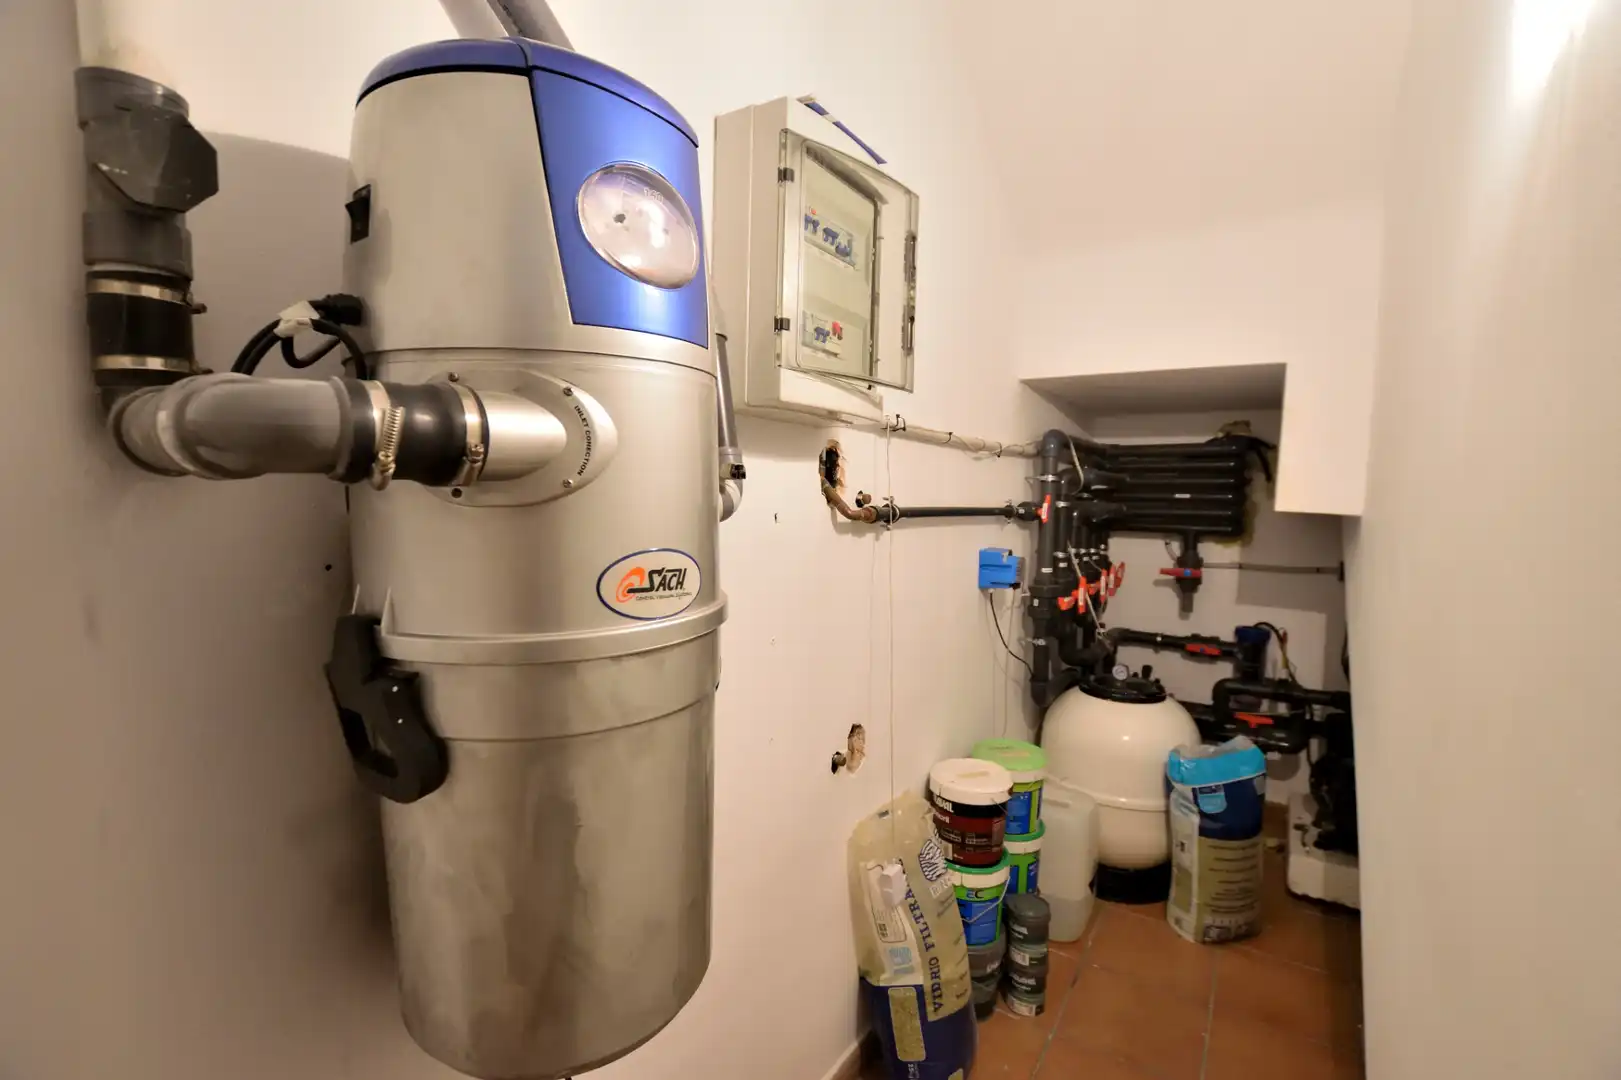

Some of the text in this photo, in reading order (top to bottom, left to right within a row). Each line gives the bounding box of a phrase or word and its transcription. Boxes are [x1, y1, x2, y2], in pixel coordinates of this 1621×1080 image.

[574, 405, 590, 427] INLET
[627, 567, 687, 593] SACH
[928, 956, 944, 1013] VIDRIO
